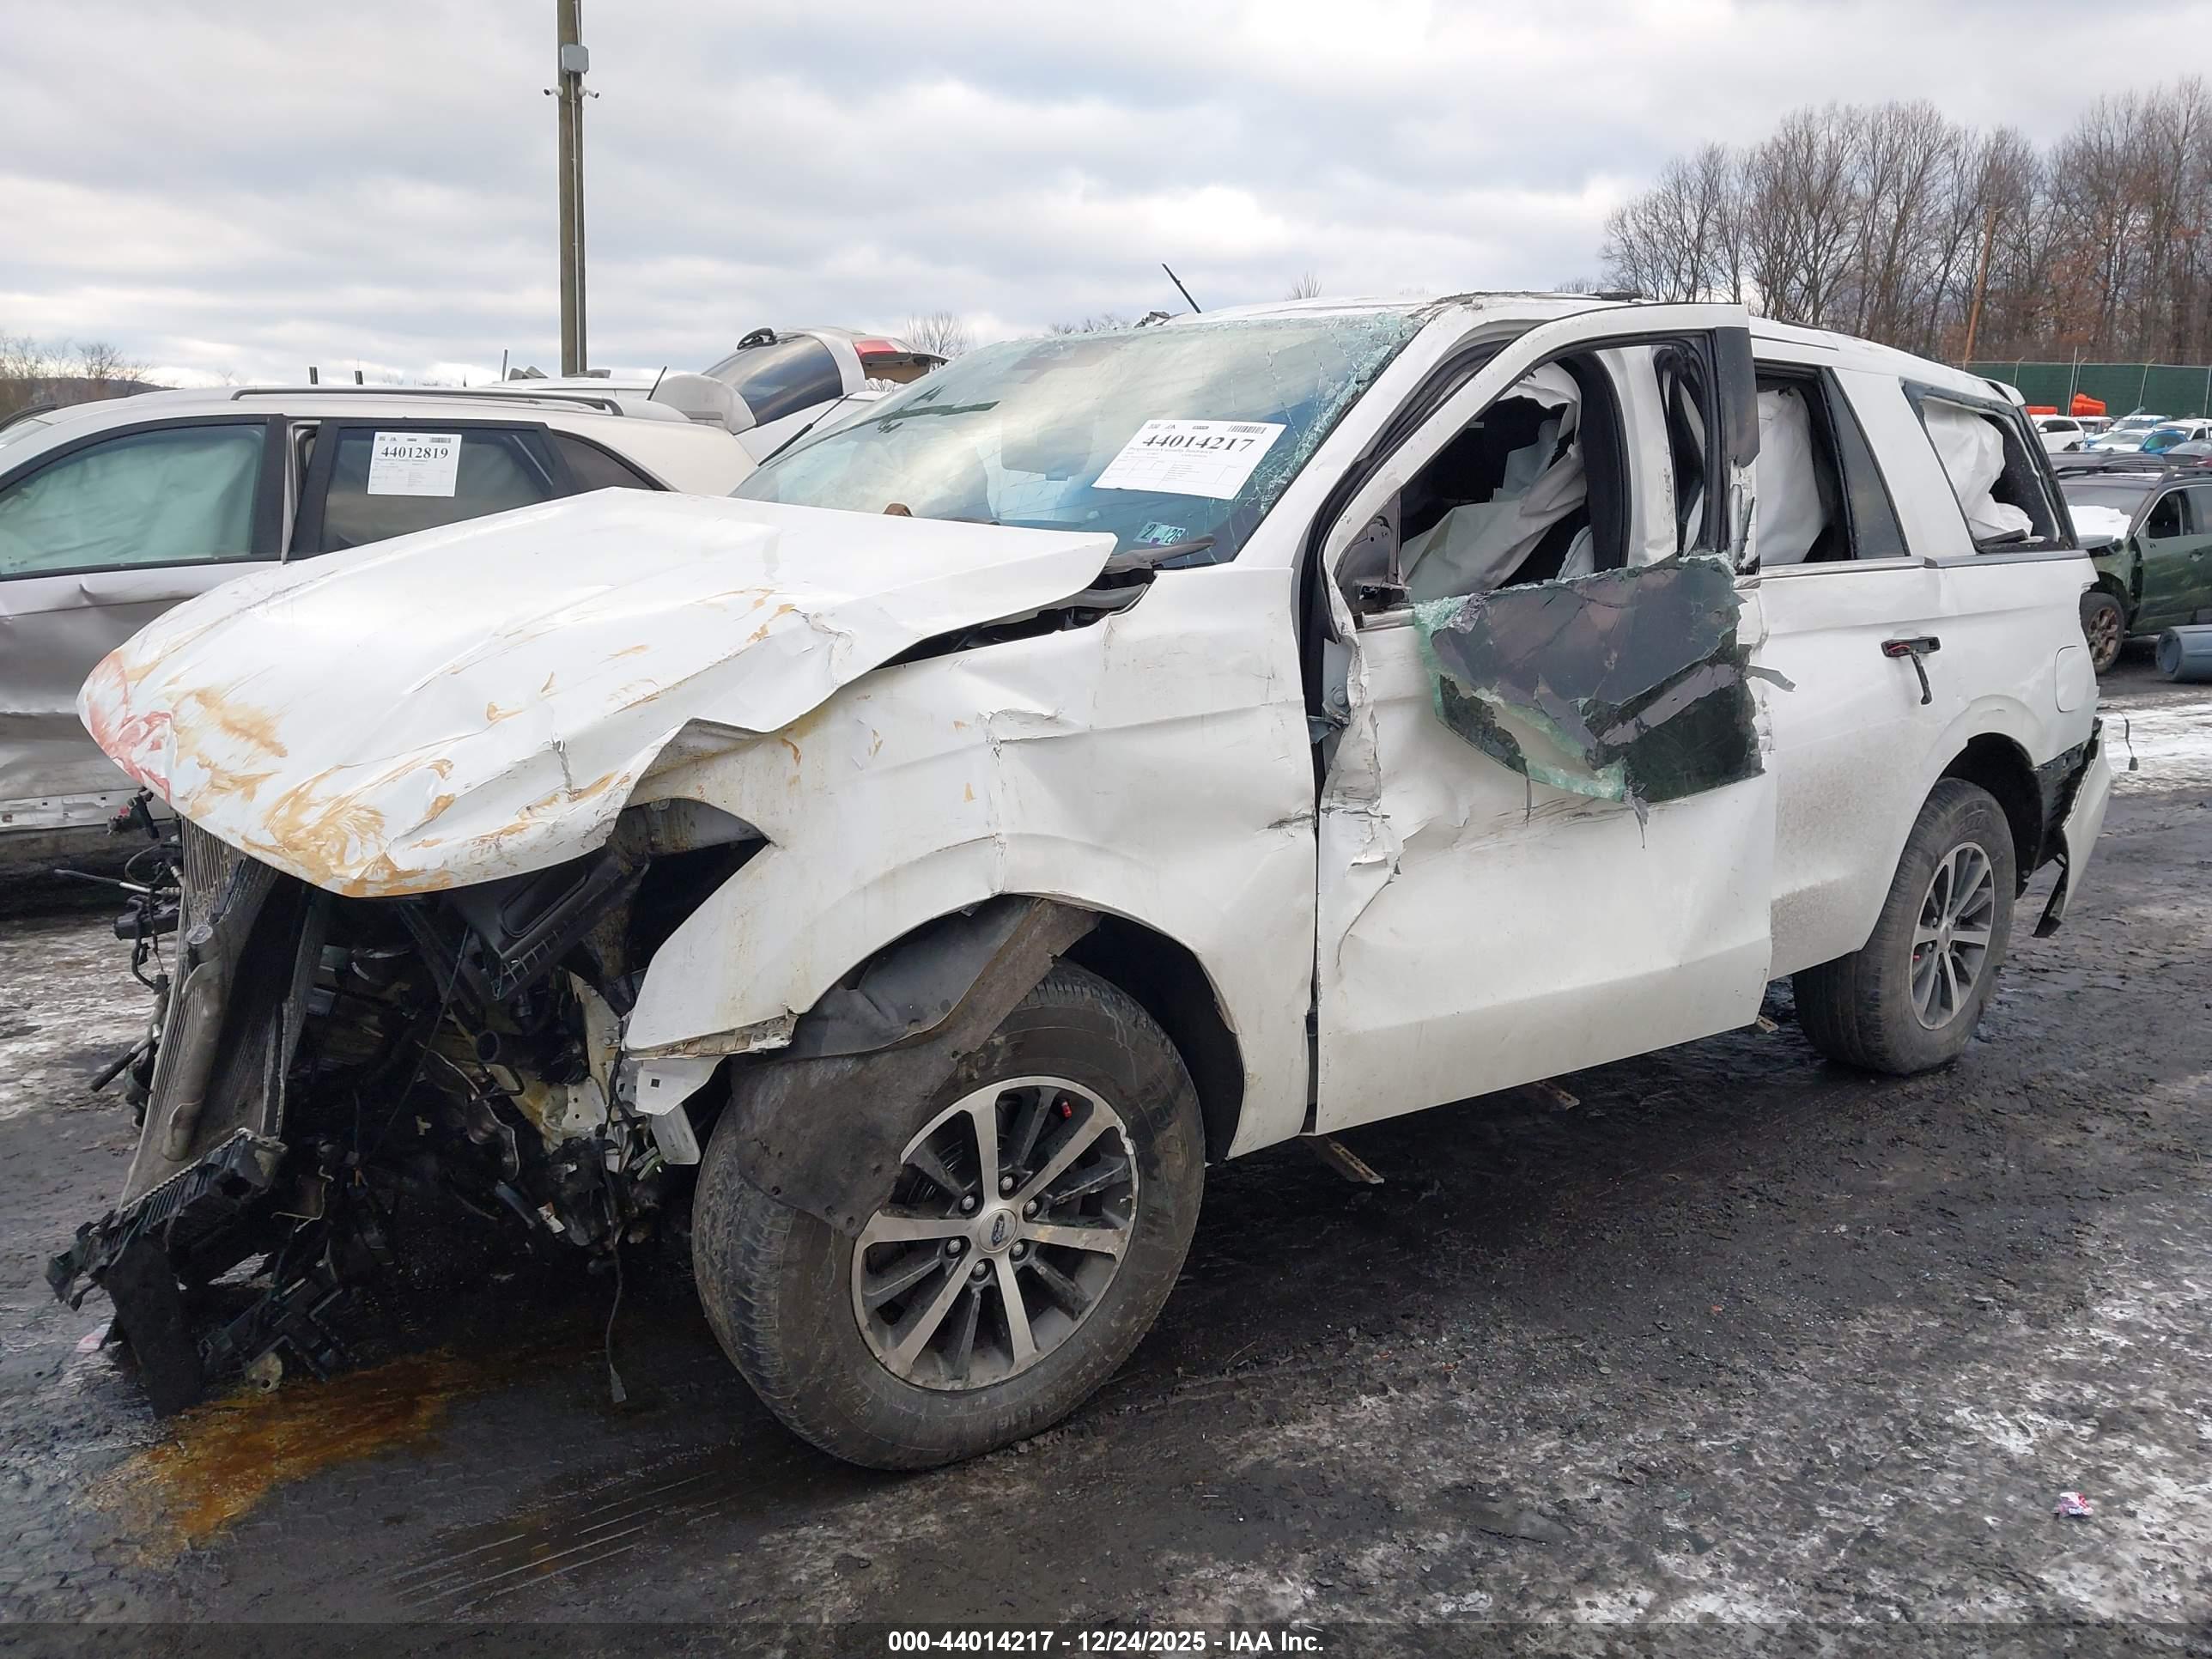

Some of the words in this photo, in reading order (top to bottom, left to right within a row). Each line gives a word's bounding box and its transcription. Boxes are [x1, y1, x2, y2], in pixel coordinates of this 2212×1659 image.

[1142, 434, 1256, 452] 44014217
[380, 446, 449, 459] 44012819
[1140, 524, 1158, 539] 2
